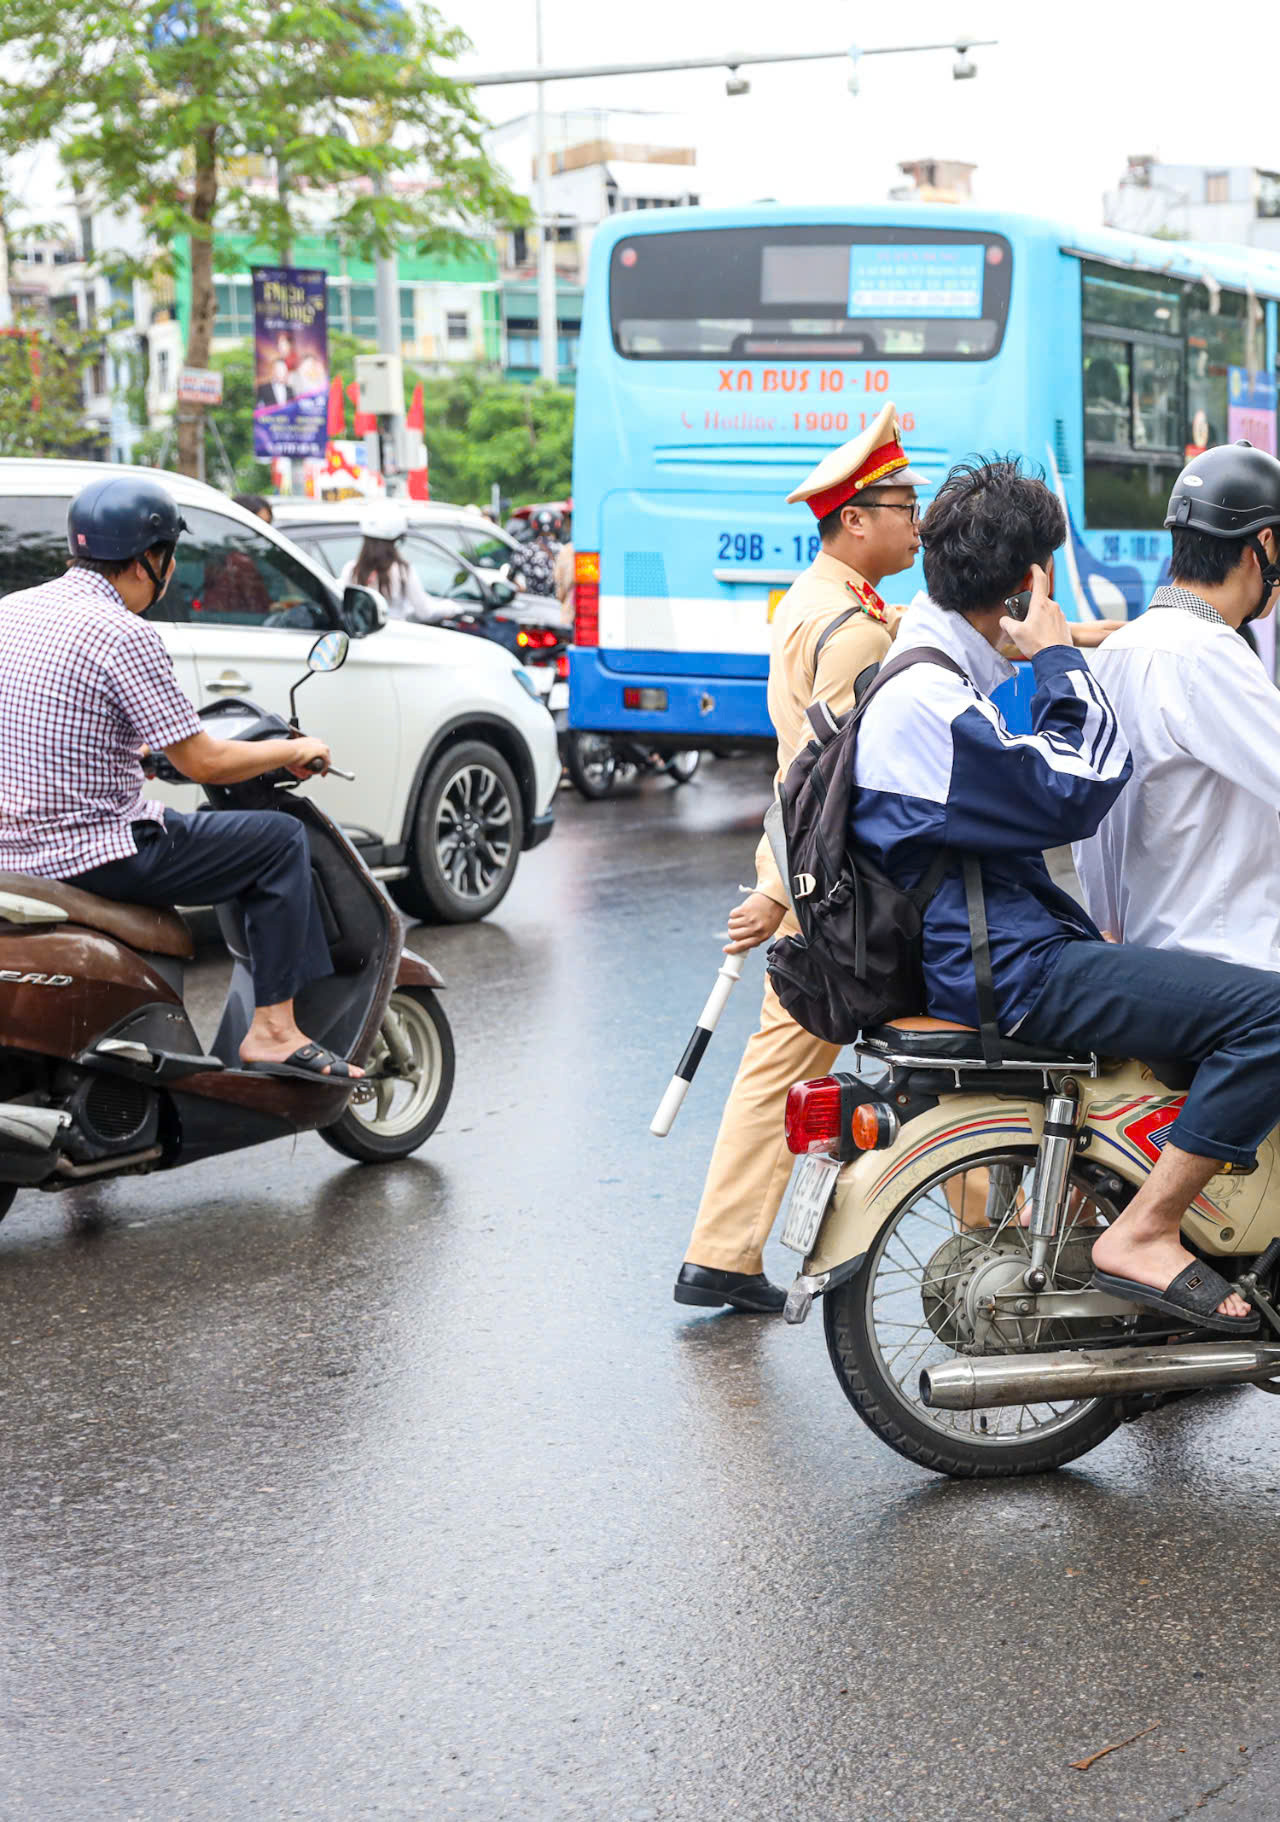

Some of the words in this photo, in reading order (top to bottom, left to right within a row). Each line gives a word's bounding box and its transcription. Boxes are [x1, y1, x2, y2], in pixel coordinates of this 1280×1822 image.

[762, 369, 811, 393] BUS
[793, 412, 849, 431] 1900
[718, 533, 764, 561] 29B
